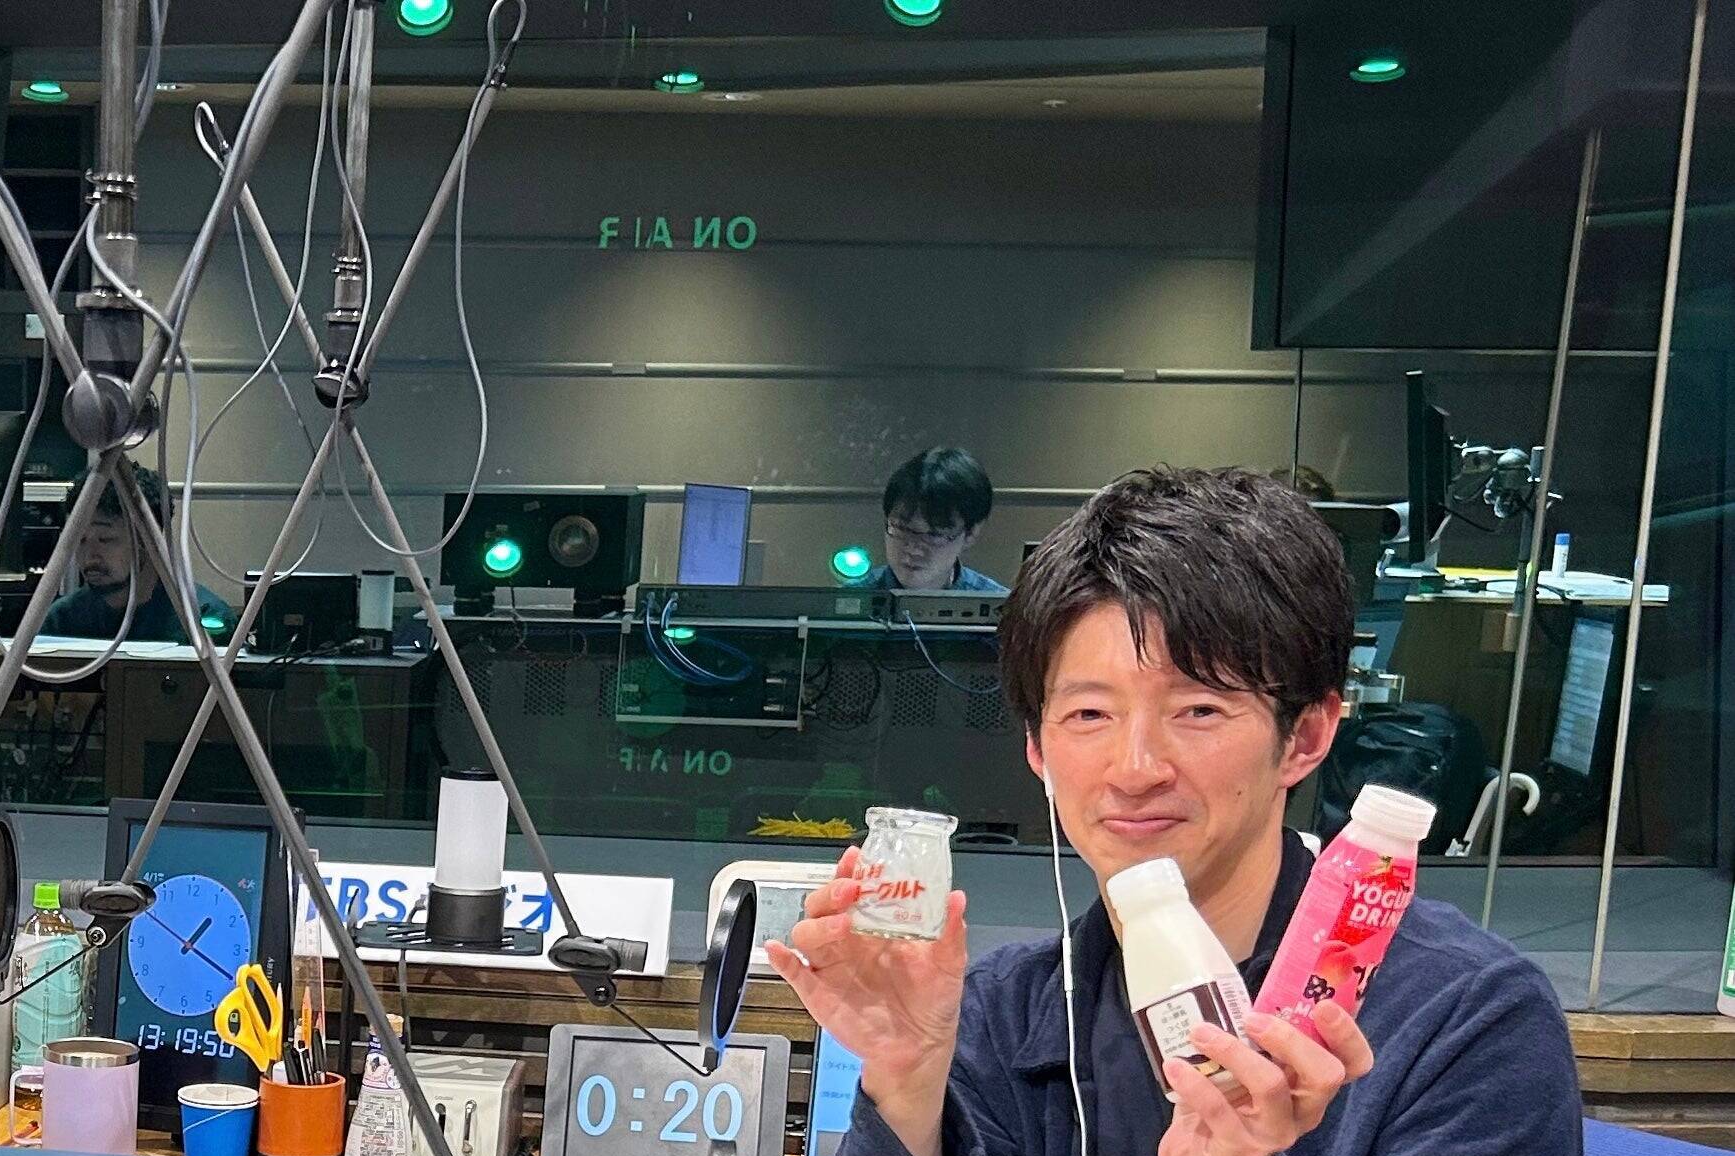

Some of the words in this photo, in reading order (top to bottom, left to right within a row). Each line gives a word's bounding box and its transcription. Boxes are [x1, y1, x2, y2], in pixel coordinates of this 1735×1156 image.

[186, 884, 201, 897] 12
[227, 915, 237, 928] 2
[137, 936, 145, 948] 9
[233, 944, 241, 956] 3
[141, 964, 149, 976] 8
[157, 985, 165, 998] 7
[205, 990, 213, 1003] 5
[180, 996, 189, 1008] 6
[576, 1074, 743, 1143] 0:20
